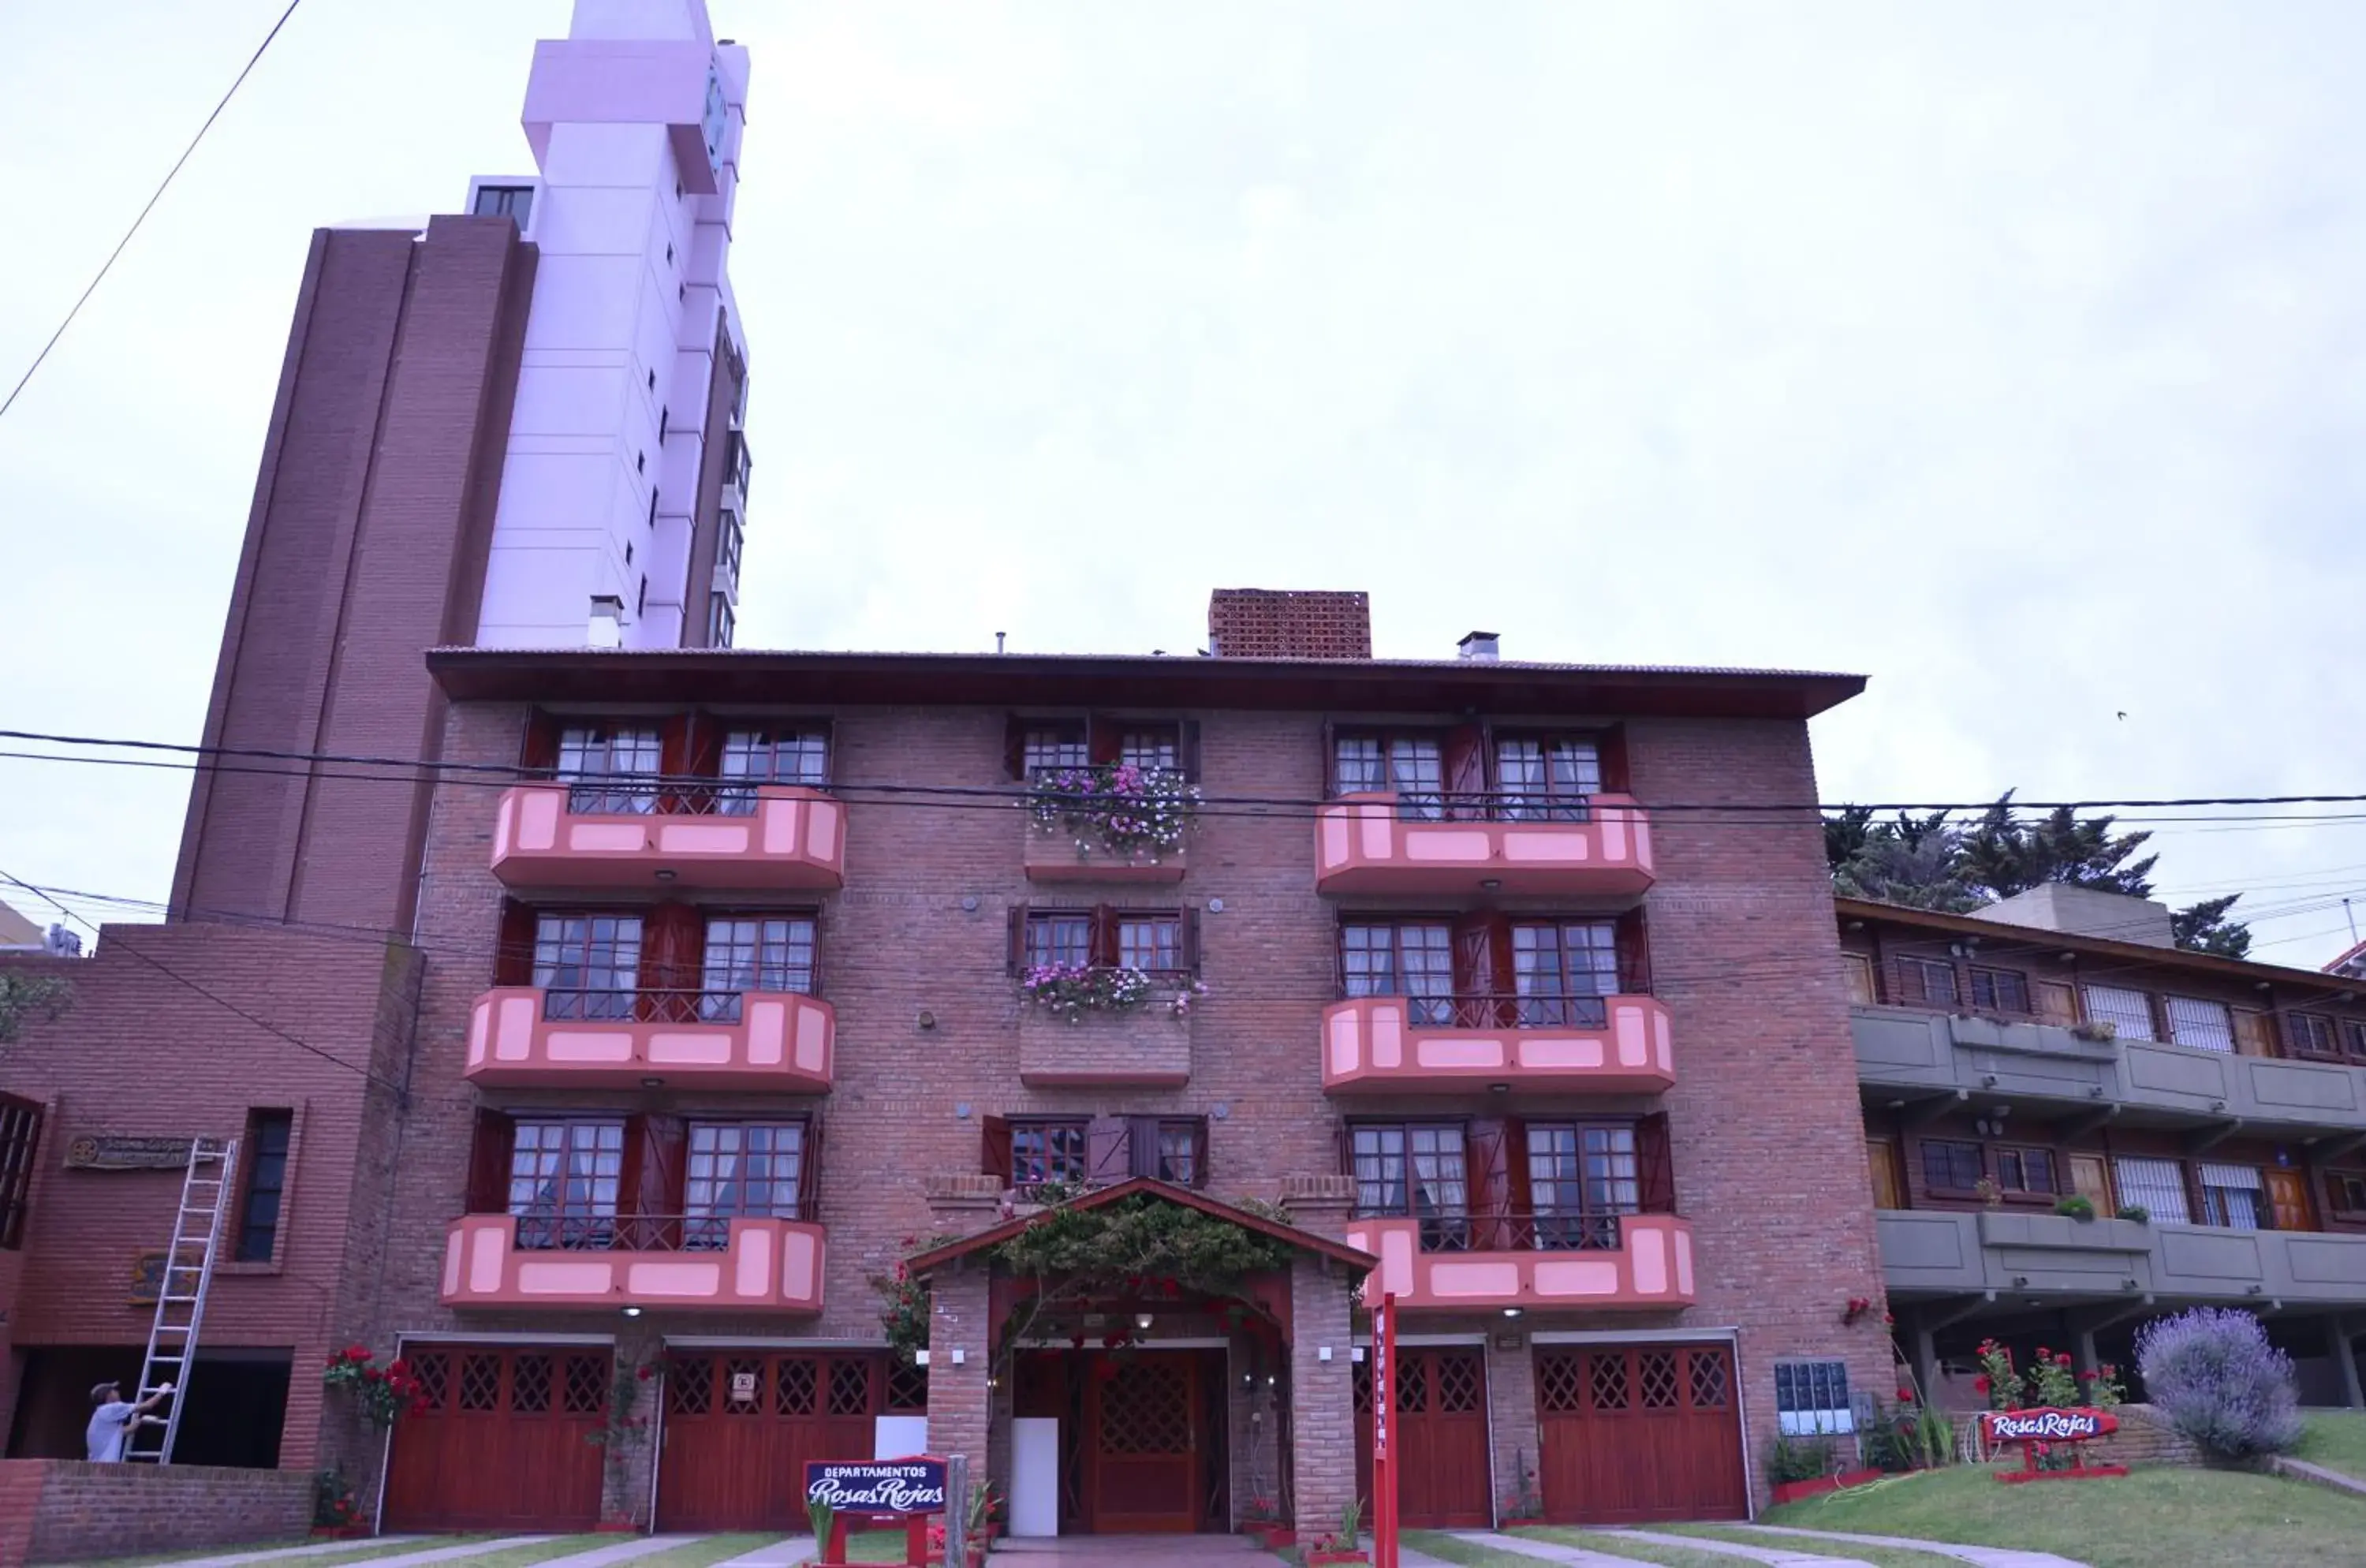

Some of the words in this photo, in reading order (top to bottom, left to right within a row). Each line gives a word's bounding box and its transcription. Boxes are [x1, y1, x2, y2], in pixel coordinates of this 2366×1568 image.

[1994, 1416, 2043, 1437] Rosas
[2043, 1413, 2094, 1437] Rojas
[824, 1466, 927, 1477] DEPARTAMENTOS
[808, 1478, 876, 1510] Rosas
[876, 1478, 944, 1511] Rojas
